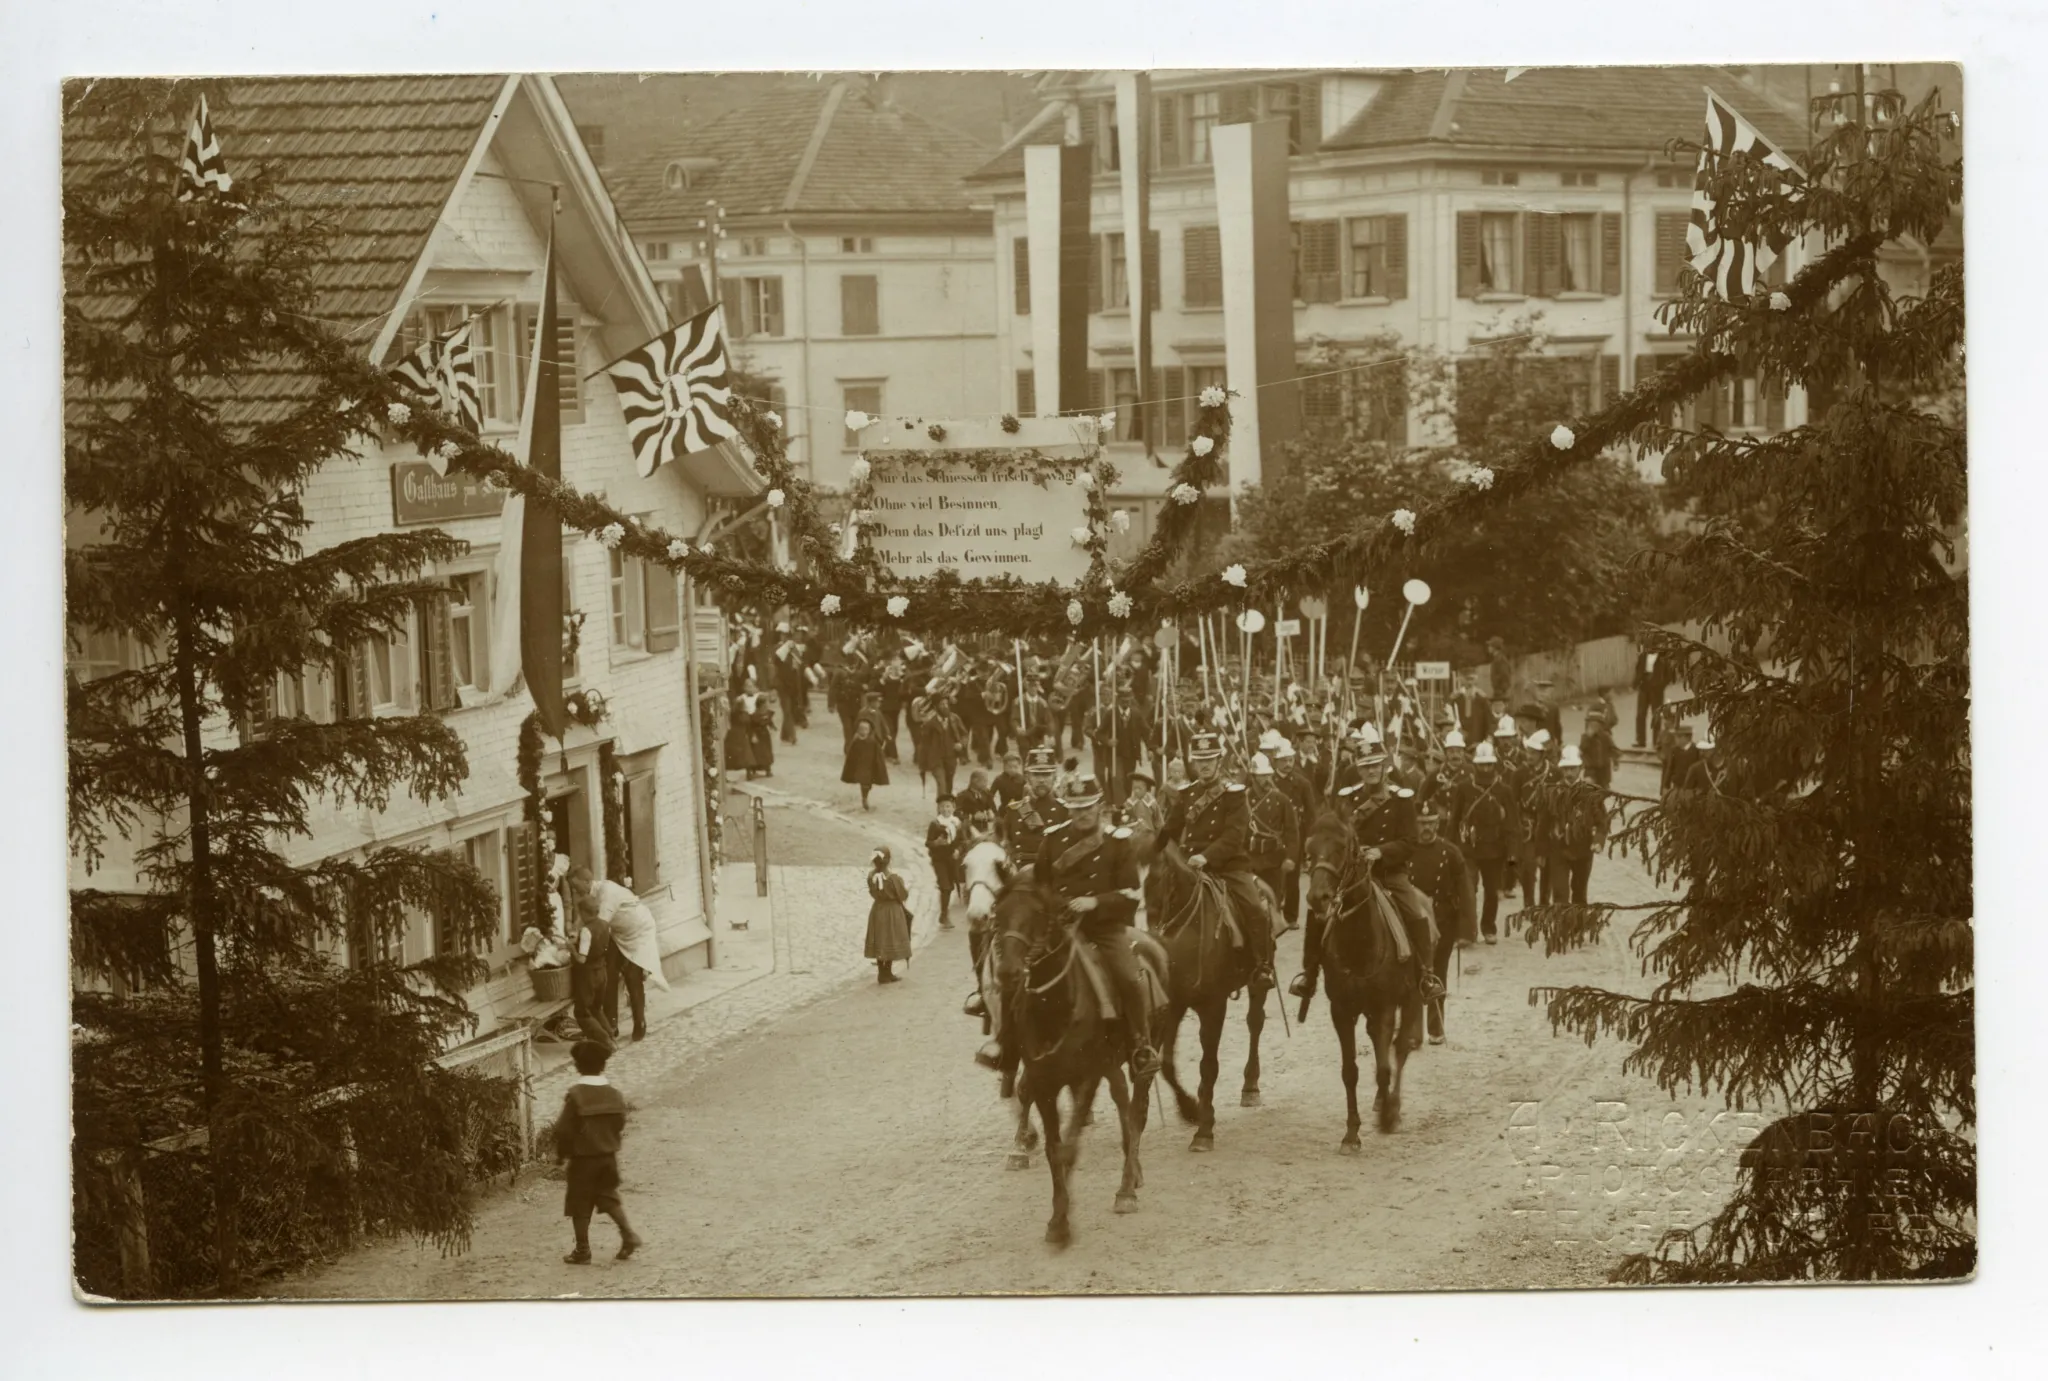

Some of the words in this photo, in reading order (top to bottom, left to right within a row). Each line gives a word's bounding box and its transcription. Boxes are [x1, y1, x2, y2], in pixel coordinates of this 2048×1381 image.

[902, 471, 923, 484] das
[992, 470, 1028, 483] frisch
[873, 496, 906, 510] Ohne
[911, 496, 933, 510] viel
[876, 522, 909, 537] Denn
[913, 523, 934, 537] das
[938, 522, 981, 537] Defizit
[985, 526, 1008, 537] uns
[1013, 522, 1044, 540] plagt
[878, 549, 912, 564] Mehr
[916, 549, 934, 564] als
[937, 549, 958, 564] das
[963, 549, 1032, 564] Gewinnen.
